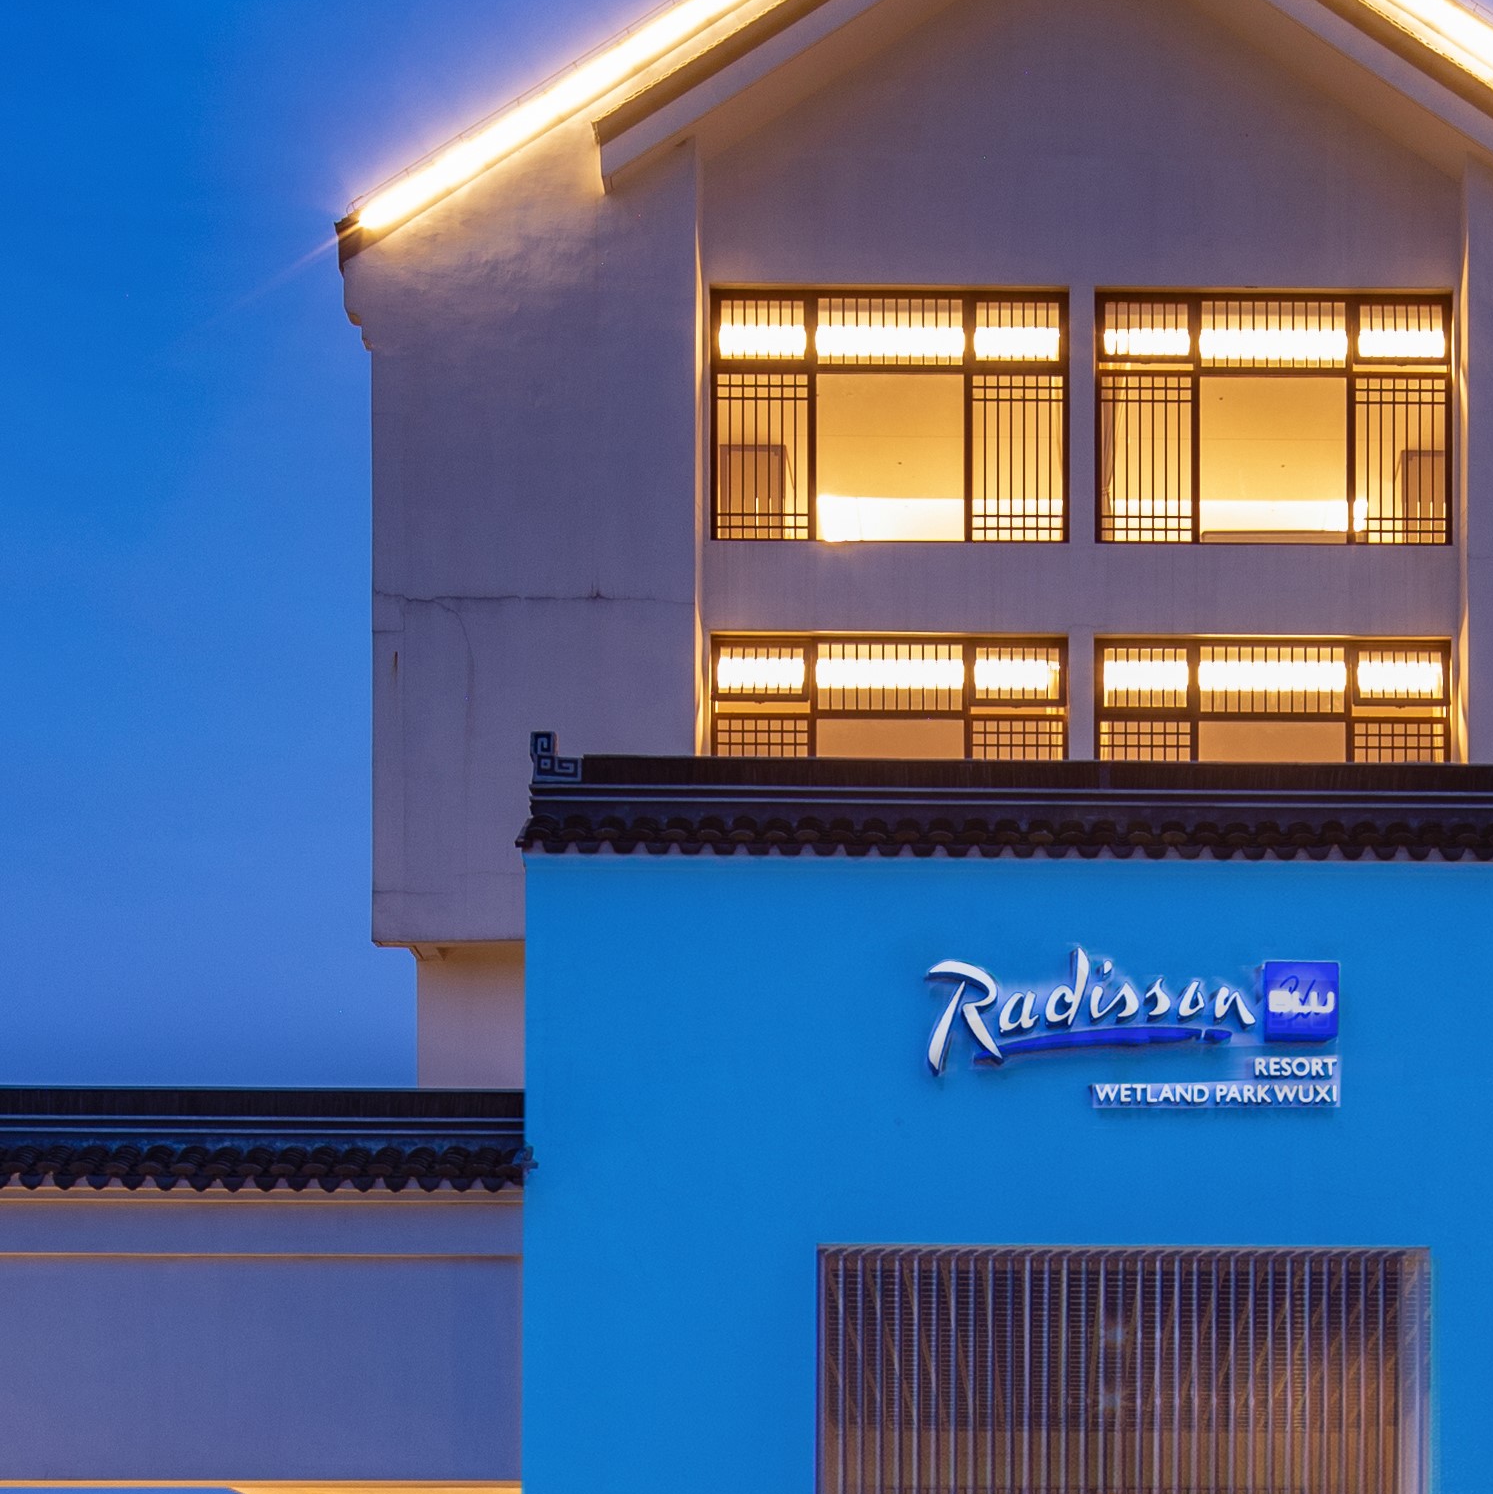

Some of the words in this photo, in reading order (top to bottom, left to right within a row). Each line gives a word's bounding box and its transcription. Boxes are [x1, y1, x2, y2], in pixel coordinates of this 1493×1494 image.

[927, 947, 1257, 1075] Radisson
[1254, 1057, 1338, 1078] RESORT
[1095, 1083, 1210, 1104] WETLAND
[1215, 1084, 1272, 1104] PARK
[1273, 1084, 1338, 1104] WUXI
